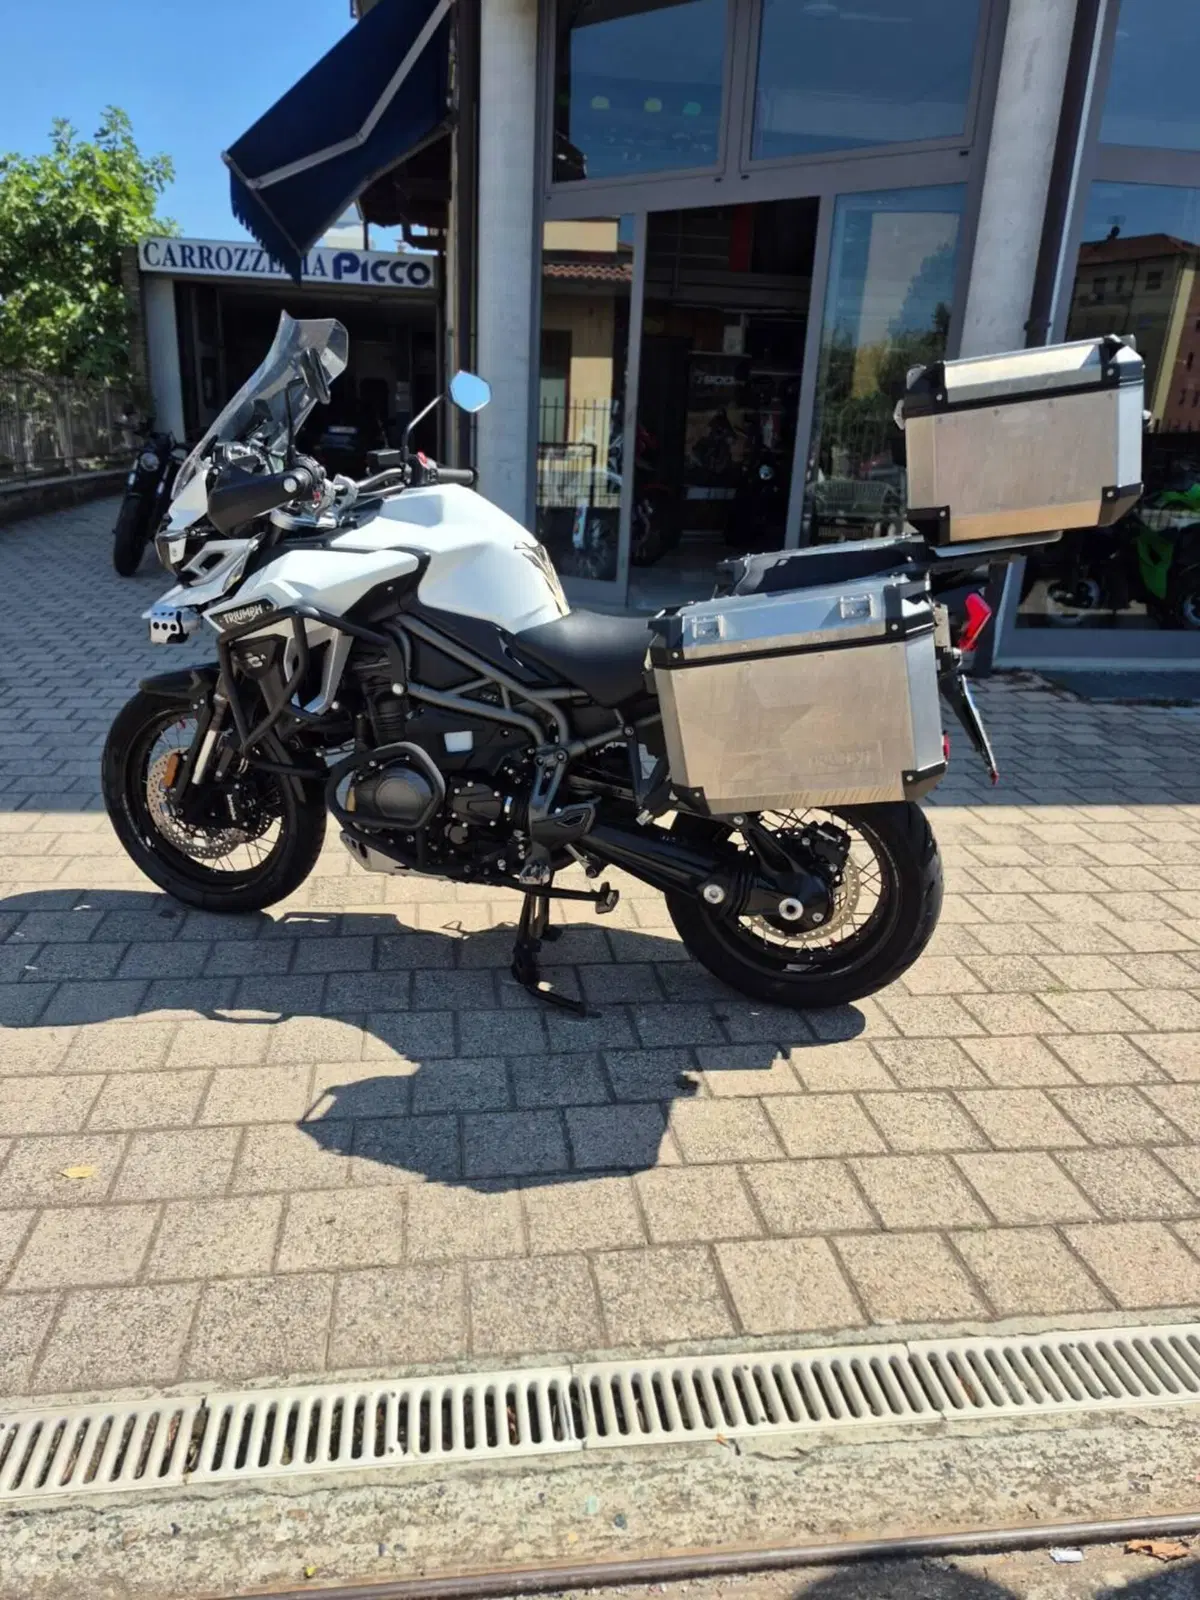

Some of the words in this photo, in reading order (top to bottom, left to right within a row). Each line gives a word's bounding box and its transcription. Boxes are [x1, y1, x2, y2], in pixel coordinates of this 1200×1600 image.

[143, 241, 328, 277] CARROZZEIA
[332, 252, 431, 286] PICCO
[222, 603, 264, 625] TRIUMPH
